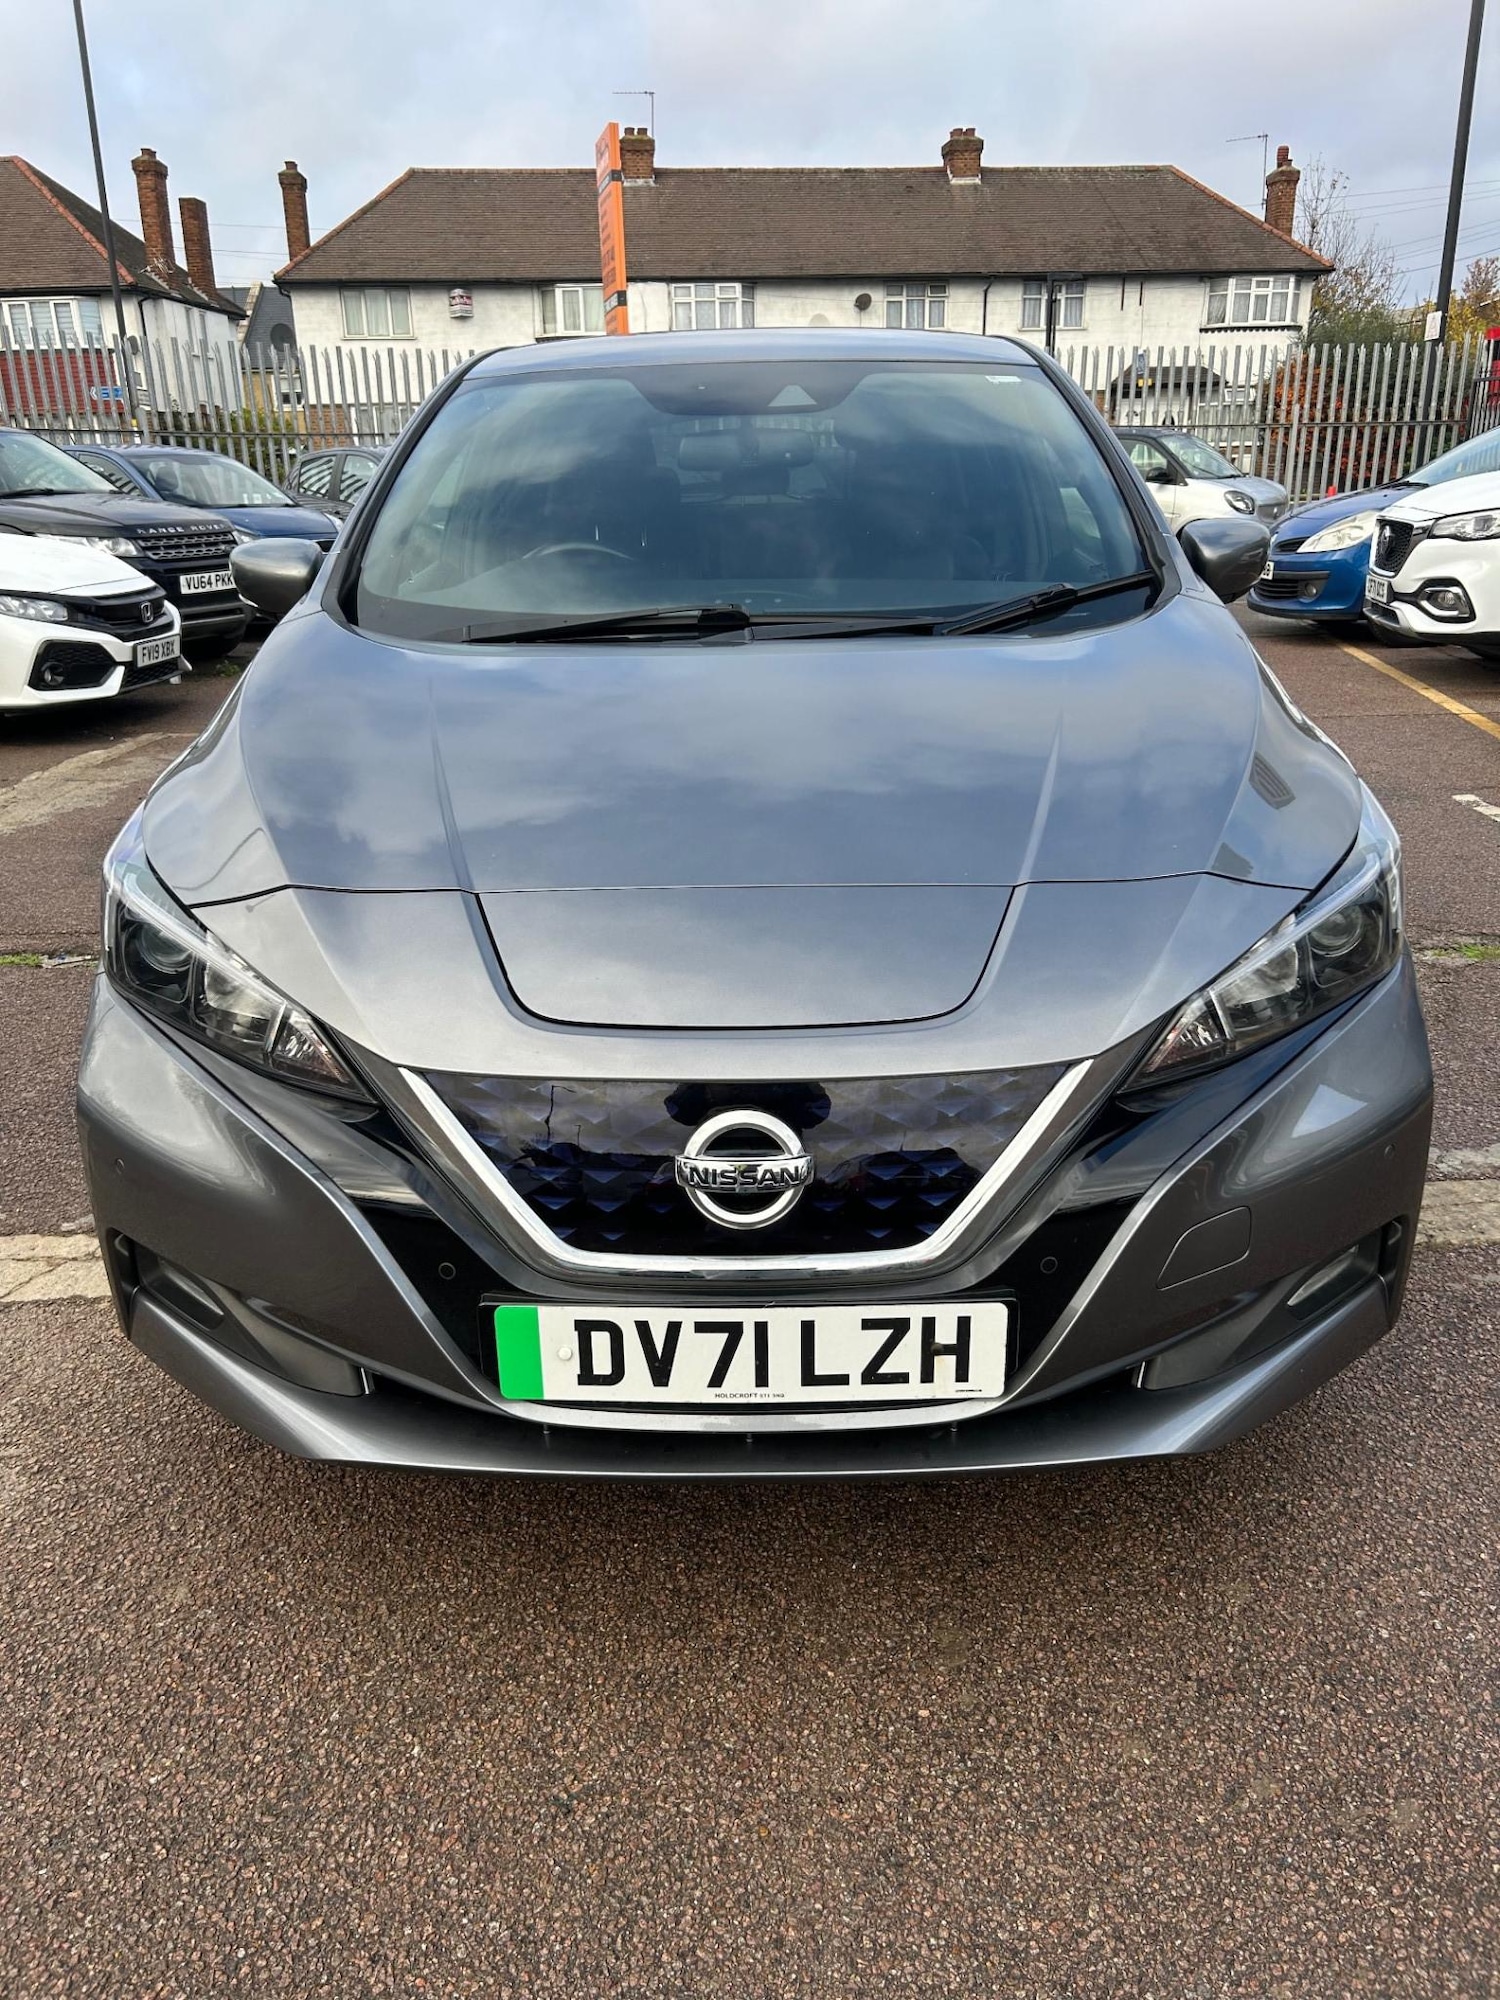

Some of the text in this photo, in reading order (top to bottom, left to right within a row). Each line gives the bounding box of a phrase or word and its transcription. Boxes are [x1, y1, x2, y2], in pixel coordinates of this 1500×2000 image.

[137, 526, 185, 534] RANGE
[185, 572, 233, 590] VU64 PKK
[142, 639, 175, 663] FV19 XBX
[689, 1165, 800, 1187] NISSAN
[573, 1315, 972, 1388] DV71 LZH
